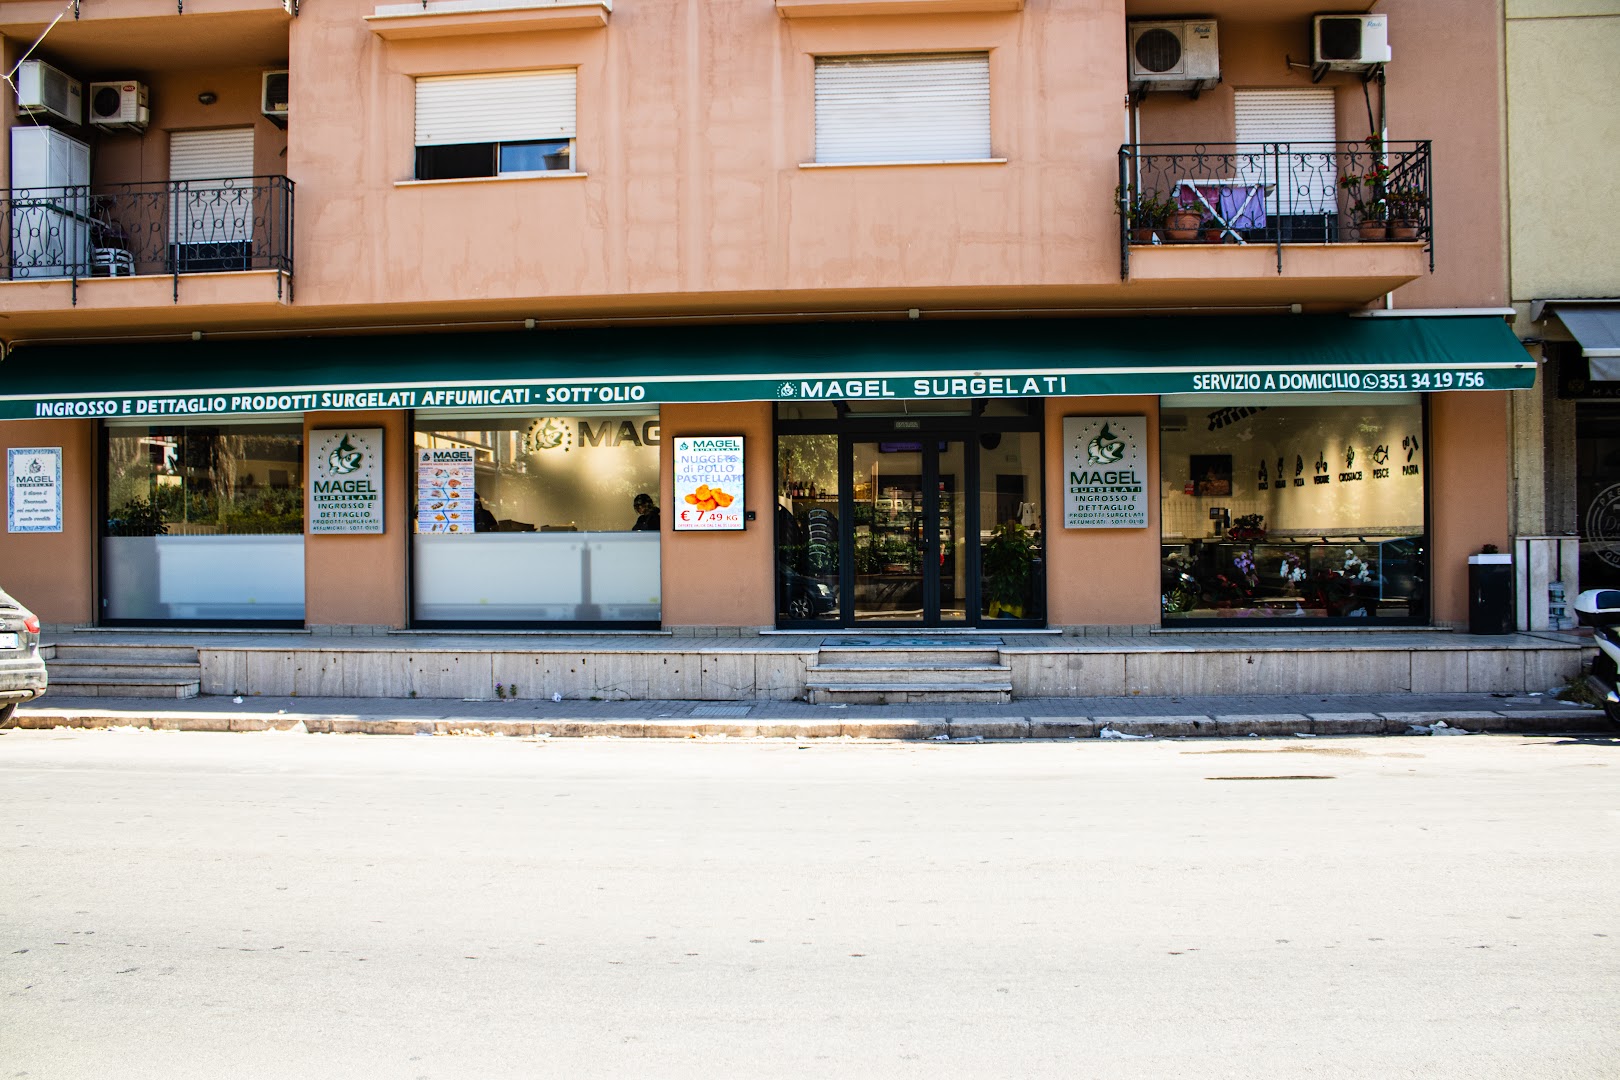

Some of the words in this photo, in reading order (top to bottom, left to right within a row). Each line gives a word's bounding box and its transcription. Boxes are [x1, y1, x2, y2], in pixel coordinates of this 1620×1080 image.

[1193, 373, 1261, 390] SERVIZIO
[1264, 373, 1276, 390] A
[1279, 372, 1361, 390] DOMICILIO
[1379, 373, 1408, 389] 351
[1411, 373, 1431, 389] 34
[1434, 372, 1453, 388] 19
[1456, 371, 1485, 387] 756
[800, 380, 895, 398] MAGEL
[914, 376, 1066, 396] SURGELATI
[36, 401, 118, 416] INGROSSO
[122, 399, 132, 414] E
[136, 398, 227, 414] DETTAGLIO
[231, 394, 317, 411] PRODOTTI
[321, 391, 416, 408] SURGELATI
[421, 389, 530, 406] AFFUMICATI
[545, 385, 645, 403] SOTT'OLIO
[694, 440, 740, 448] MAGEL
[684, 464, 694, 473] di
[698, 464, 735, 472] POLLO
[1373, 468, 1390, 479] PESCE
[1402, 464, 1419, 476] PASTA
[1070, 472, 1141, 484] MAGEL
[314, 480, 377, 494] MAGEL
[680, 510, 690, 521] €
[696, 510, 722, 522] 7,49
